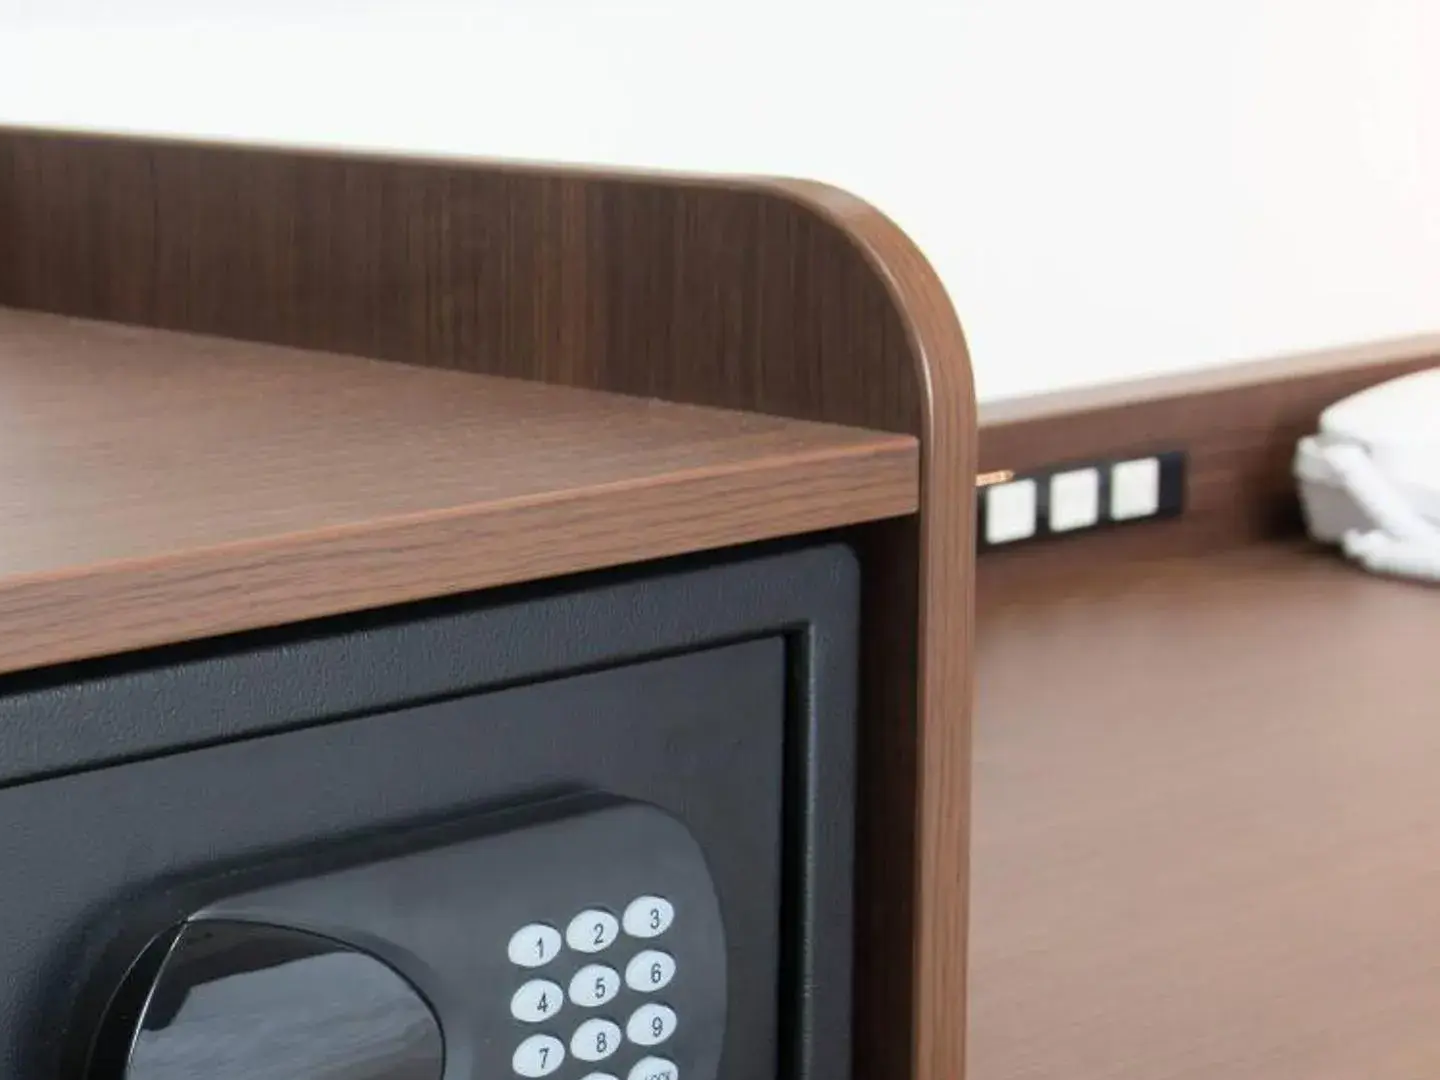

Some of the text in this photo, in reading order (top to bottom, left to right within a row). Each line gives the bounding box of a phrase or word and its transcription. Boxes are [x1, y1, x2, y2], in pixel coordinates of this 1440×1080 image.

[536, 908, 661, 959] 1 2 3
[536, 962, 662, 1013] 4 5 6
[539, 1016, 664, 1069] 7 8 9
